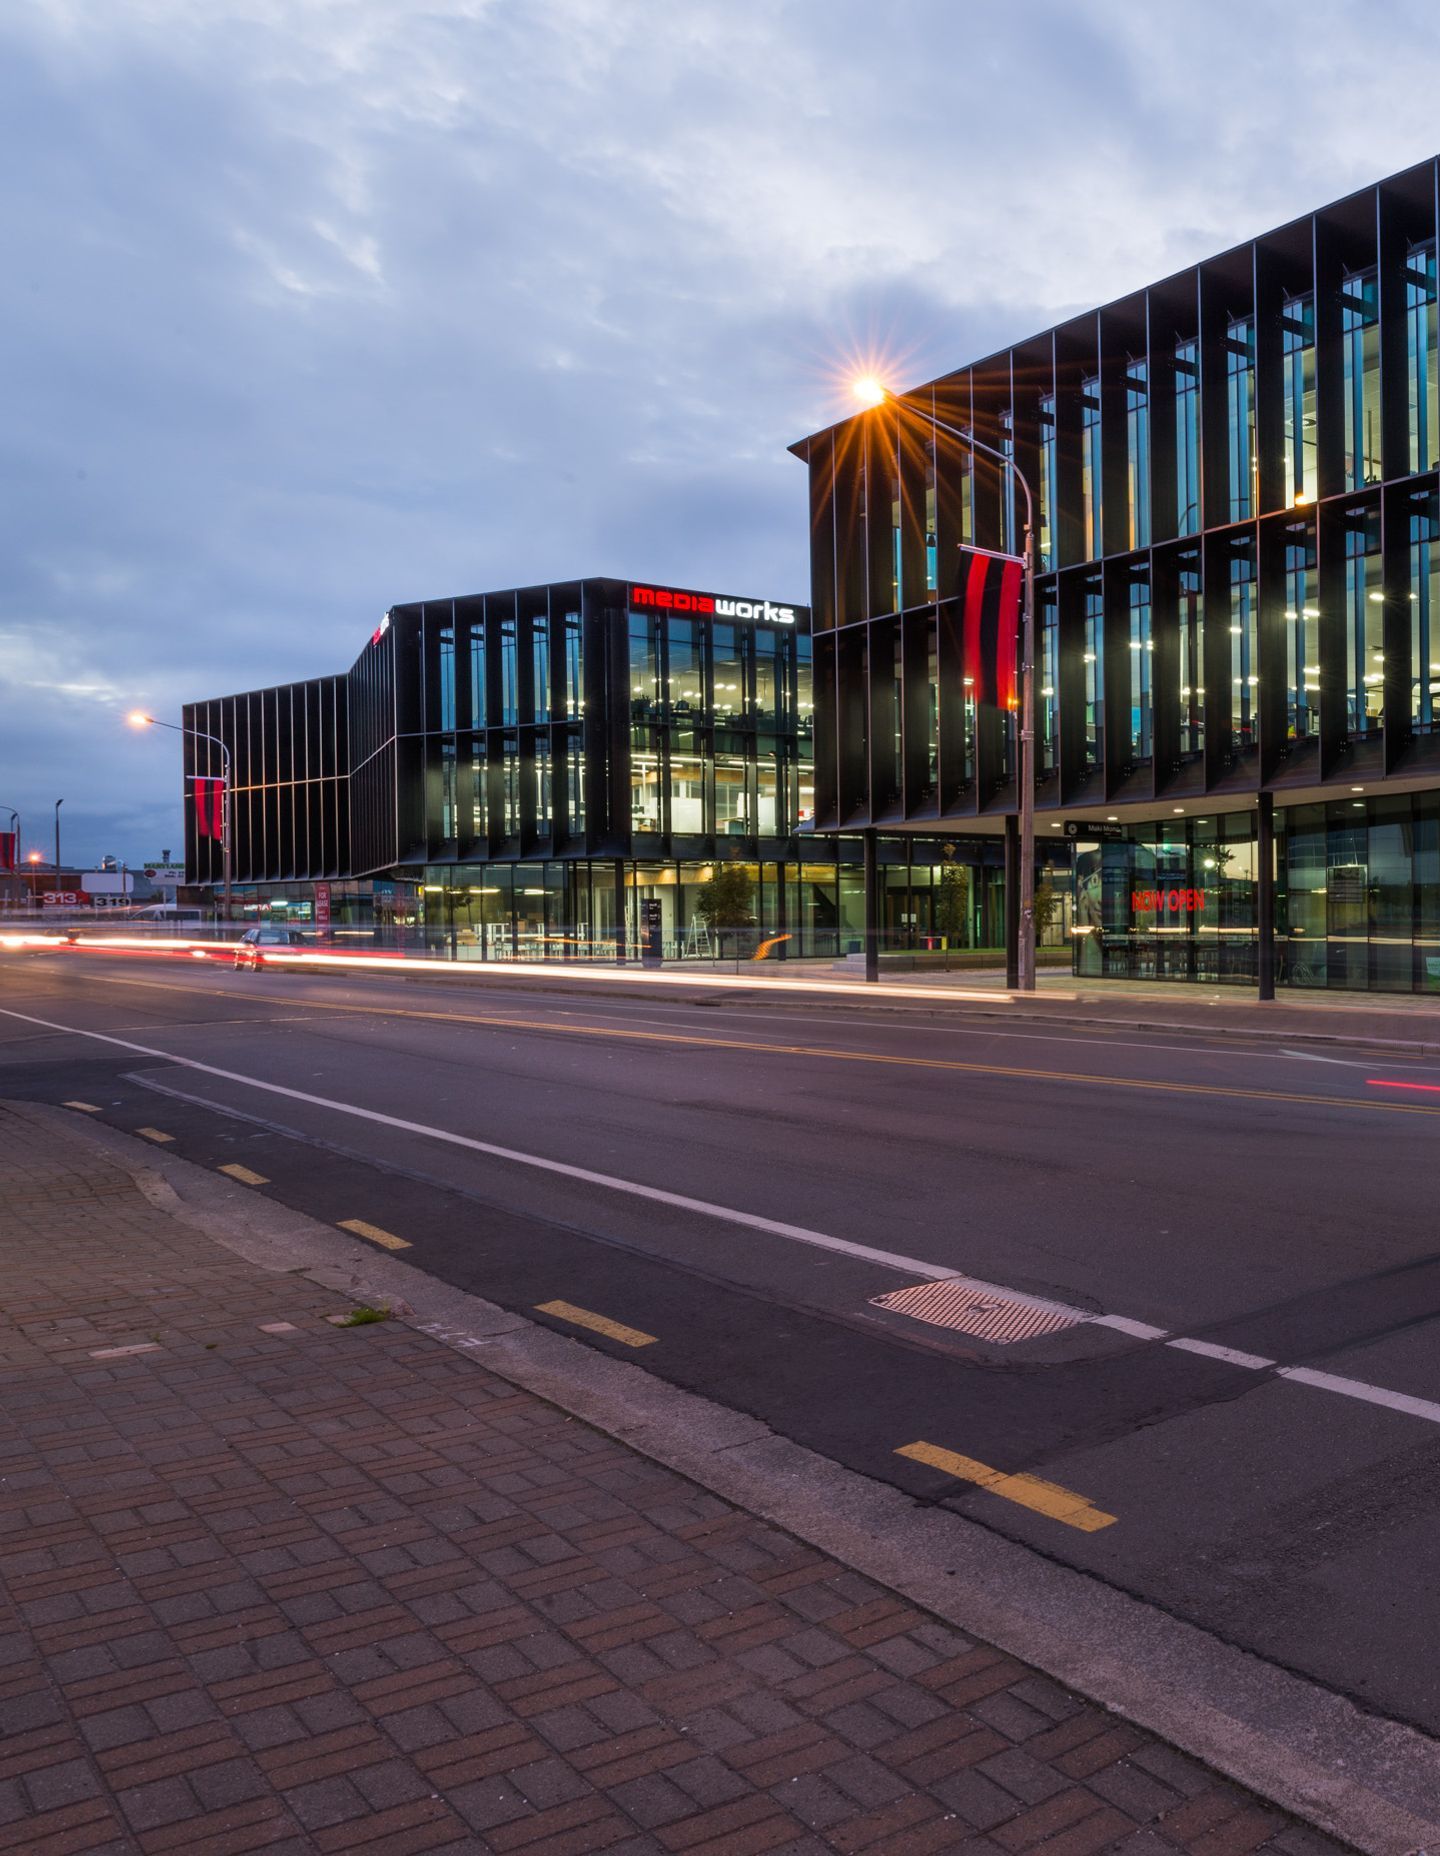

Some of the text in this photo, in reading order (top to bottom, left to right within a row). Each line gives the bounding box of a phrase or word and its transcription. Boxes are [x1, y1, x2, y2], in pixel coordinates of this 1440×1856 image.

[43, 892, 77, 904] 313
[97, 898, 130, 907] 319
[1132, 888, 1205, 912] NOW OPEN
